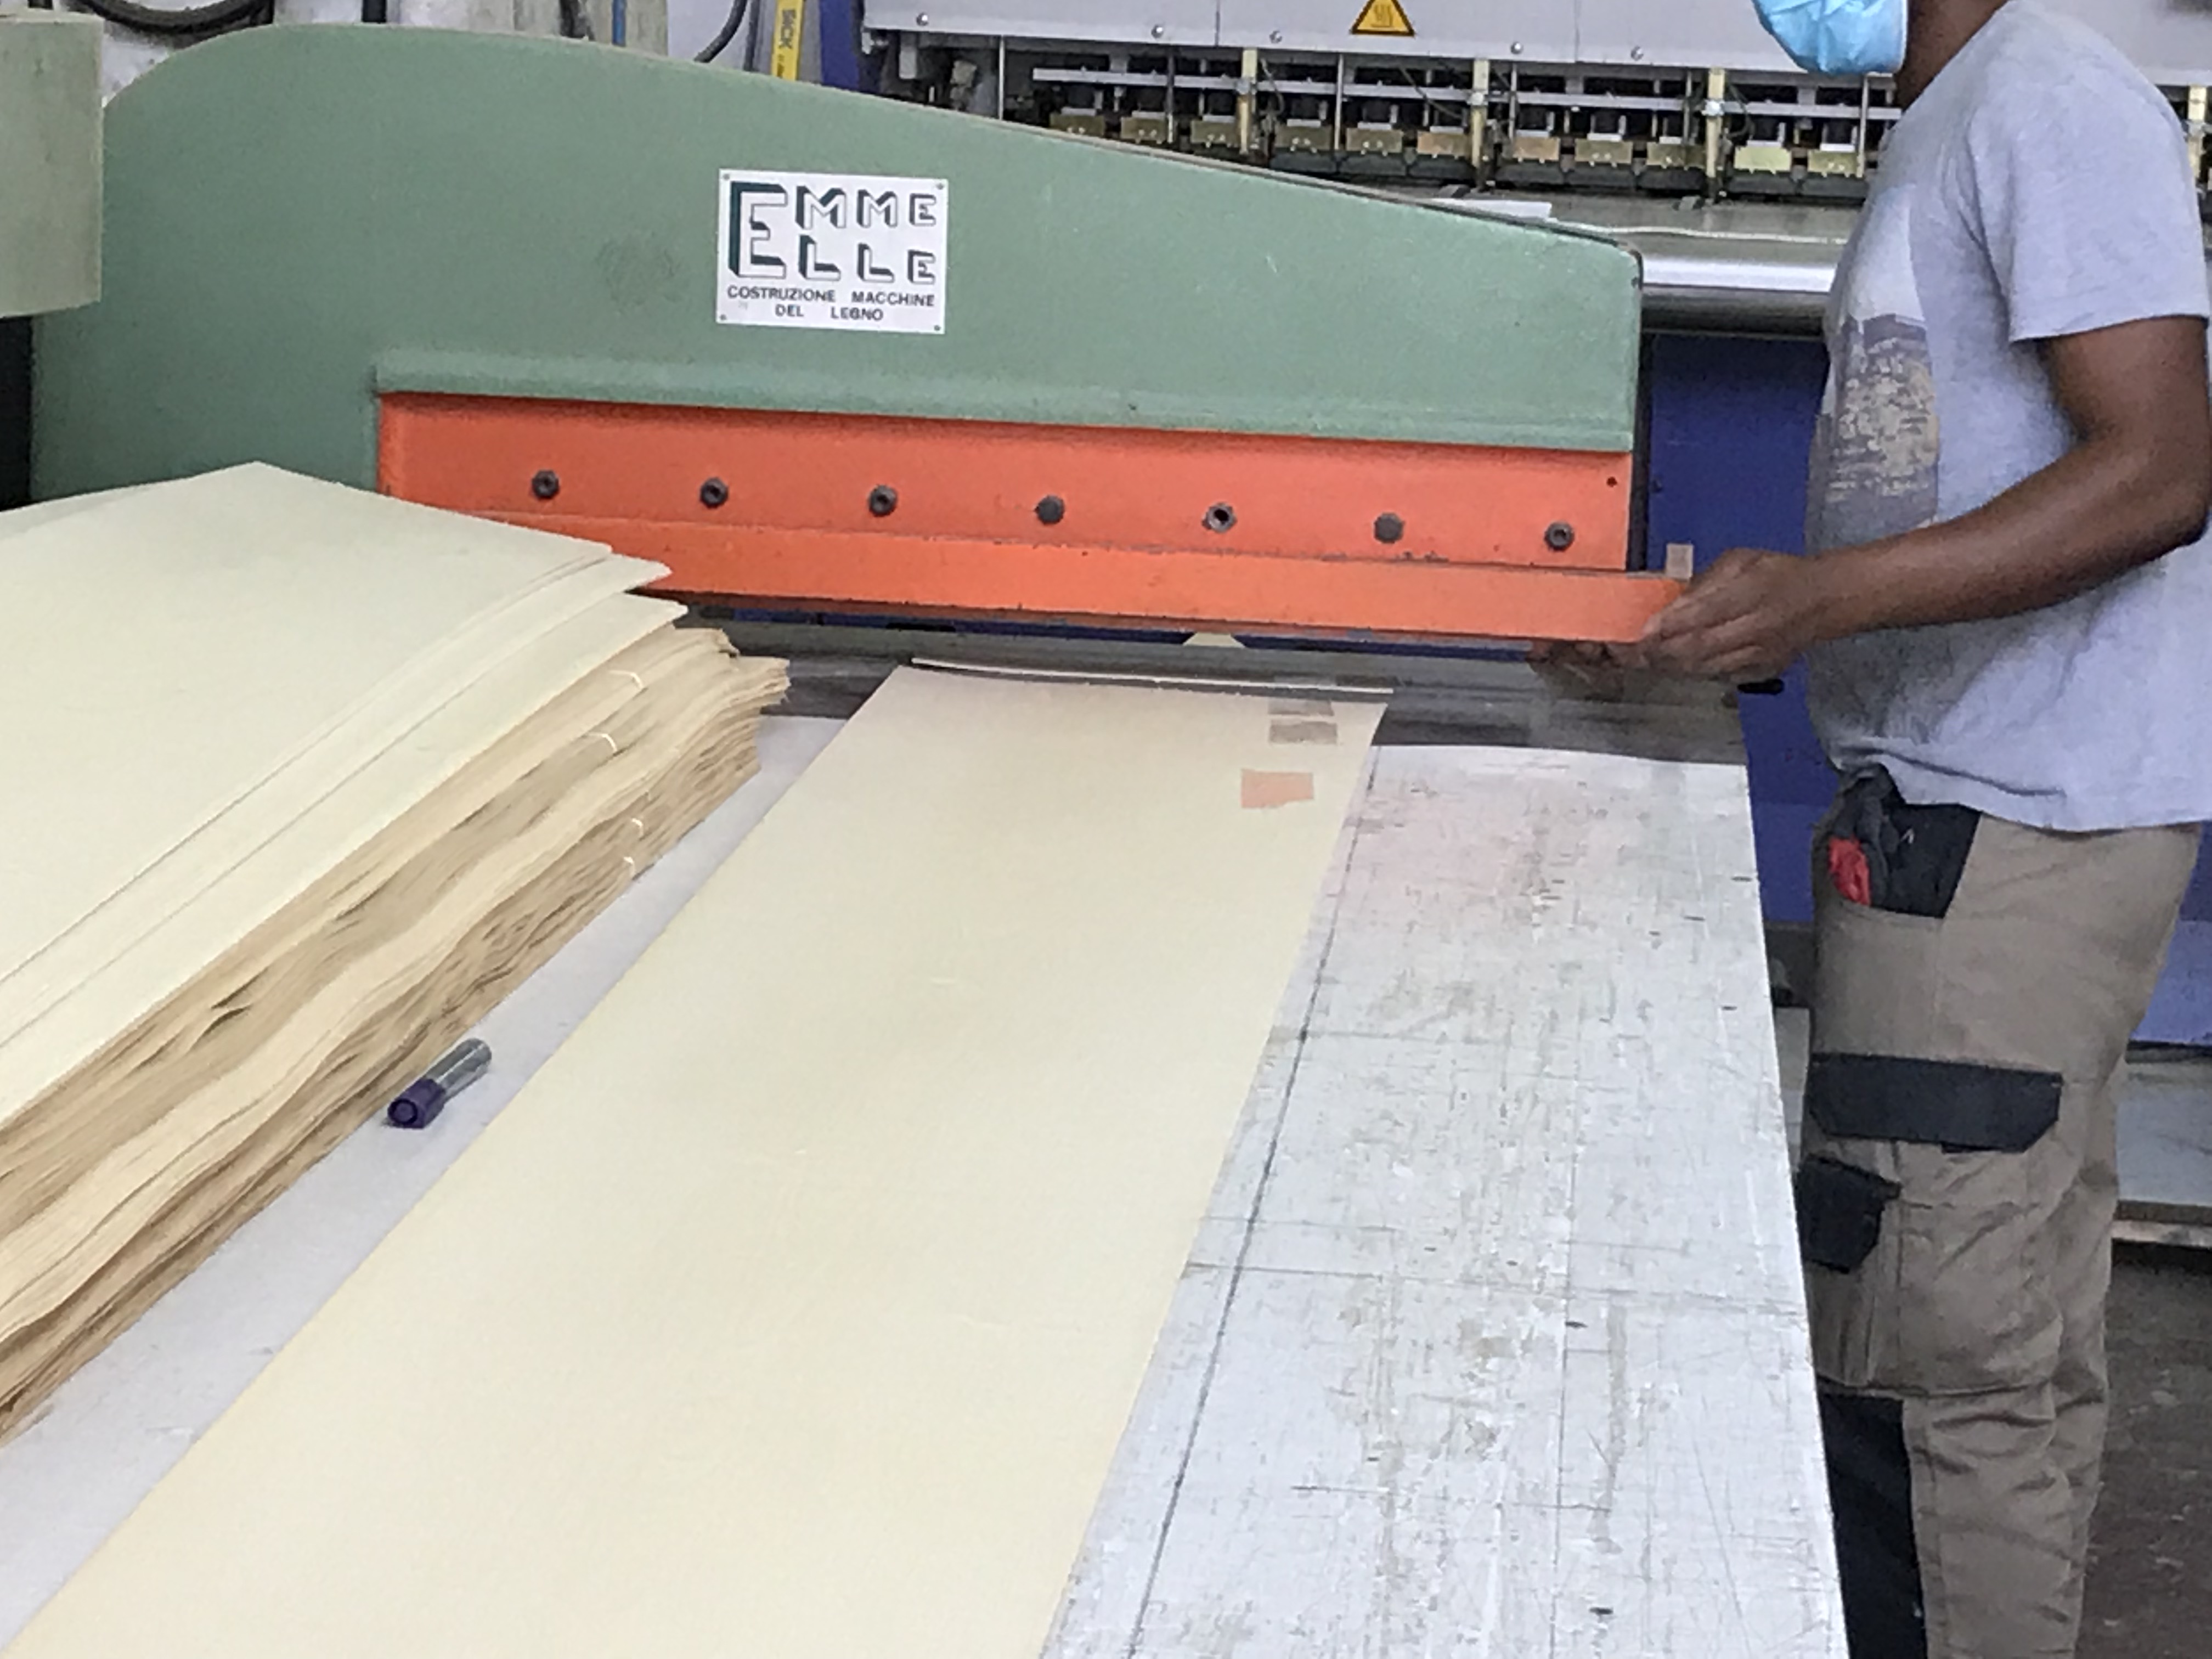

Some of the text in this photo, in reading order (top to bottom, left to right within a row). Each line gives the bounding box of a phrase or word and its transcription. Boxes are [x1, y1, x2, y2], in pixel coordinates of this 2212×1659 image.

[727, 285, 935, 307] COSTRUZIONE MACCHINE
[775, 303, 804, 317] DEL
